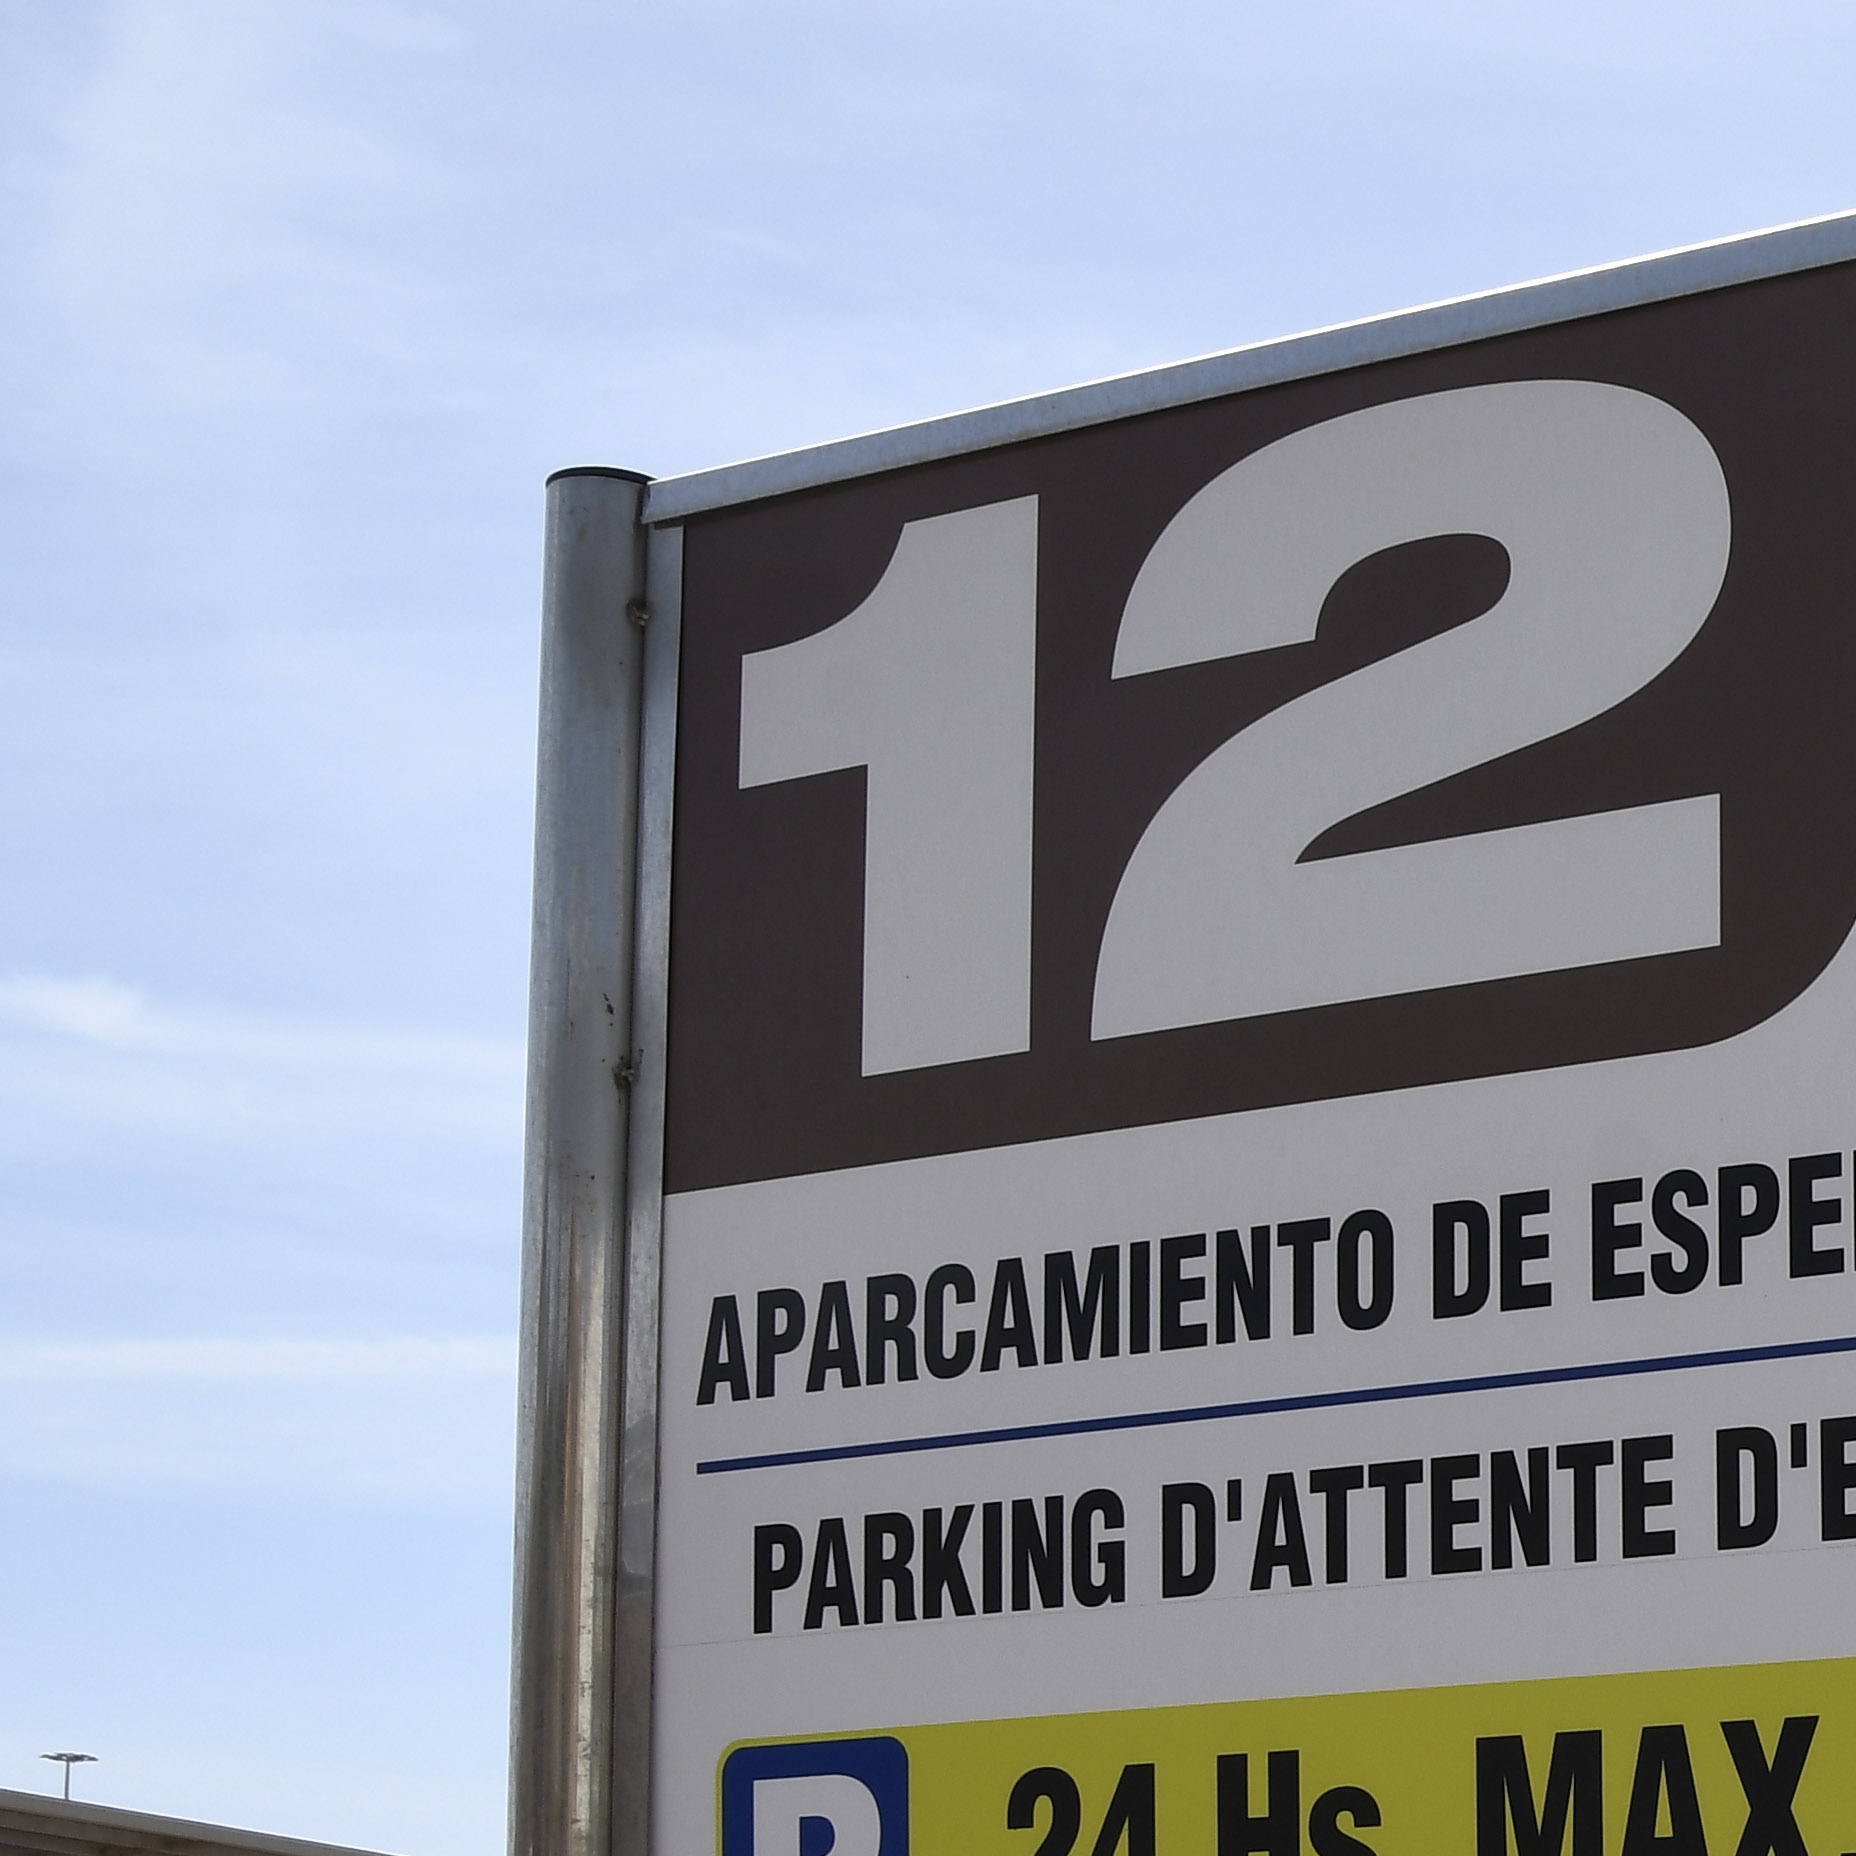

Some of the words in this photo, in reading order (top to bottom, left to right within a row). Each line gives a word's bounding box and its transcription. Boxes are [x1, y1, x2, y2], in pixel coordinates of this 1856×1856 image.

[738, 378, 1732, 1077] 12
[697, 1209, 1395, 1405] APARCAMIENTO
[1432, 1188, 1552, 1320] DE
[753, 1487, 1127, 1634] PARKING
[1161, 1433, 1676, 1599] D'ATTENTE
